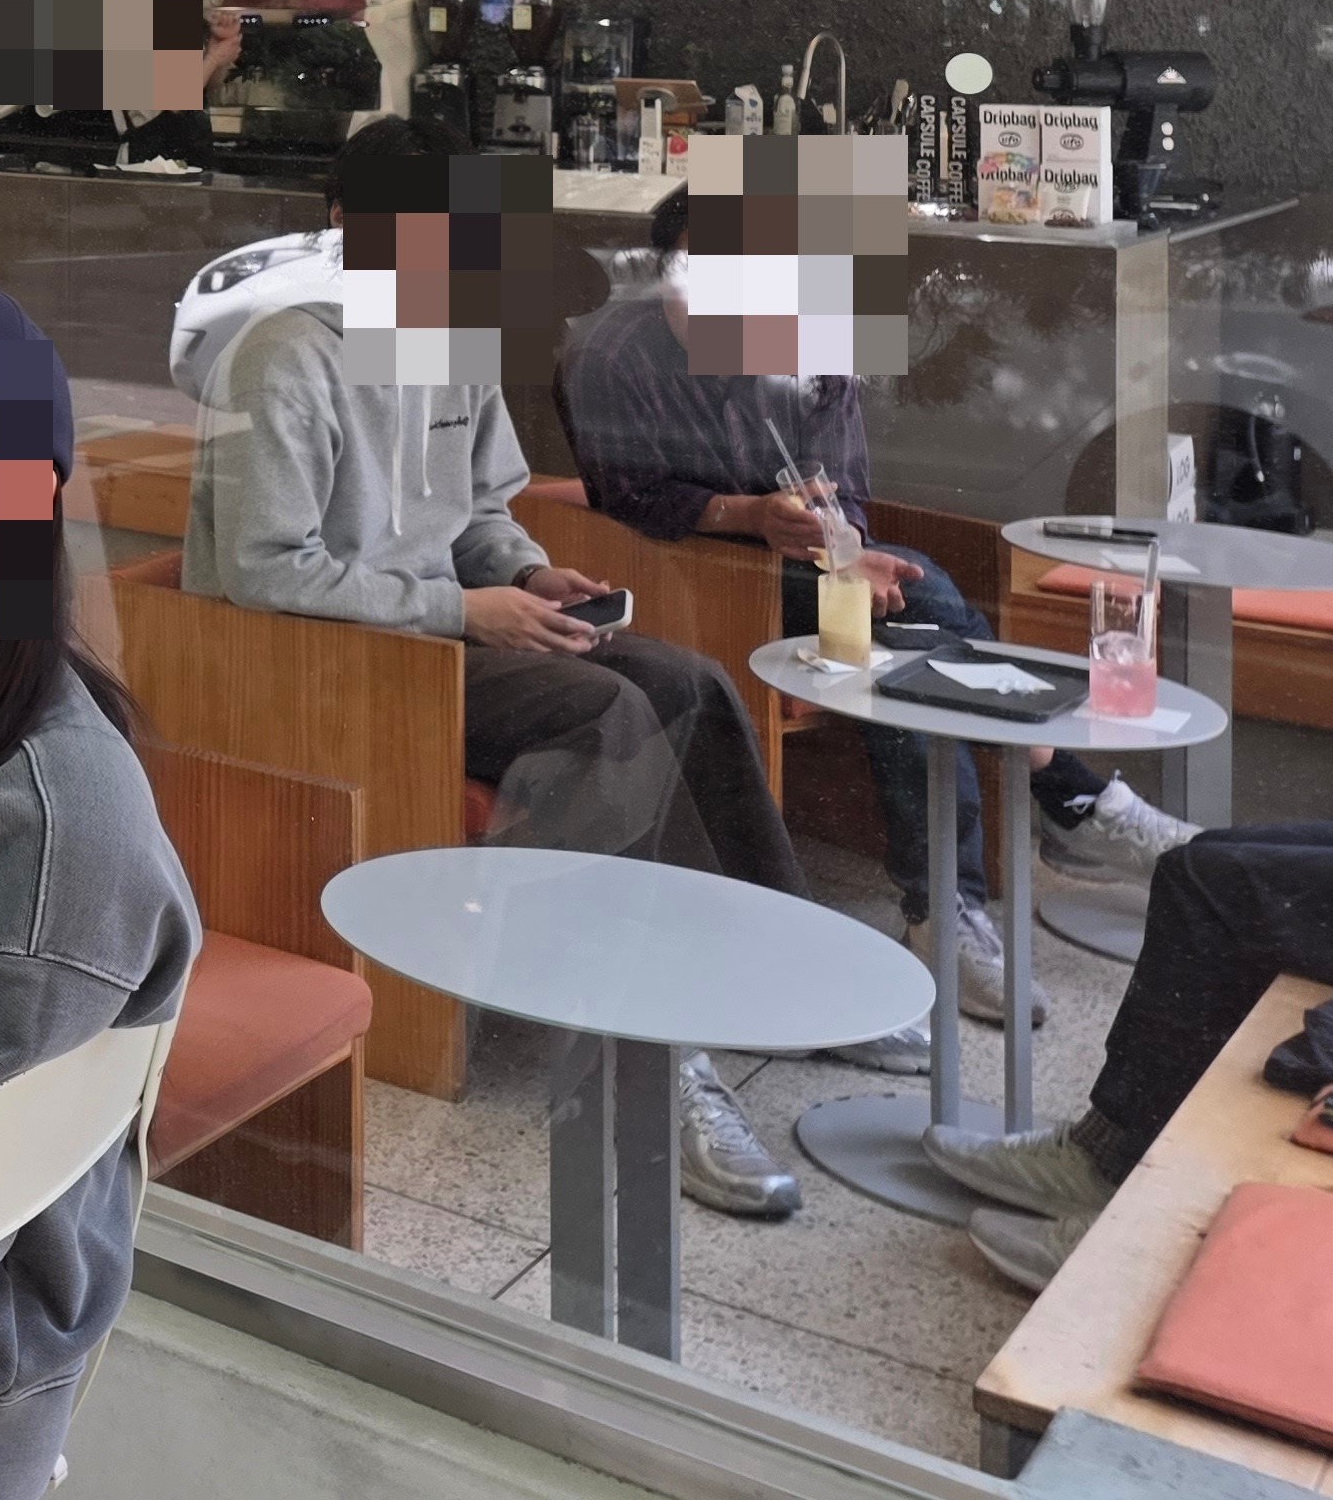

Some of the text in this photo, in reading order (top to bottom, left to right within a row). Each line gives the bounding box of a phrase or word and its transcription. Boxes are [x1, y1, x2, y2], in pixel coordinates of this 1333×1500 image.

[920, 95, 936, 158] CAPSULE
[951, 96, 967, 159] CAPSULE
[983, 110, 1037, 129] Dripbag
[1044, 112, 1098, 132] Dripbag
[1044, 169, 1098, 188] Dripbag
